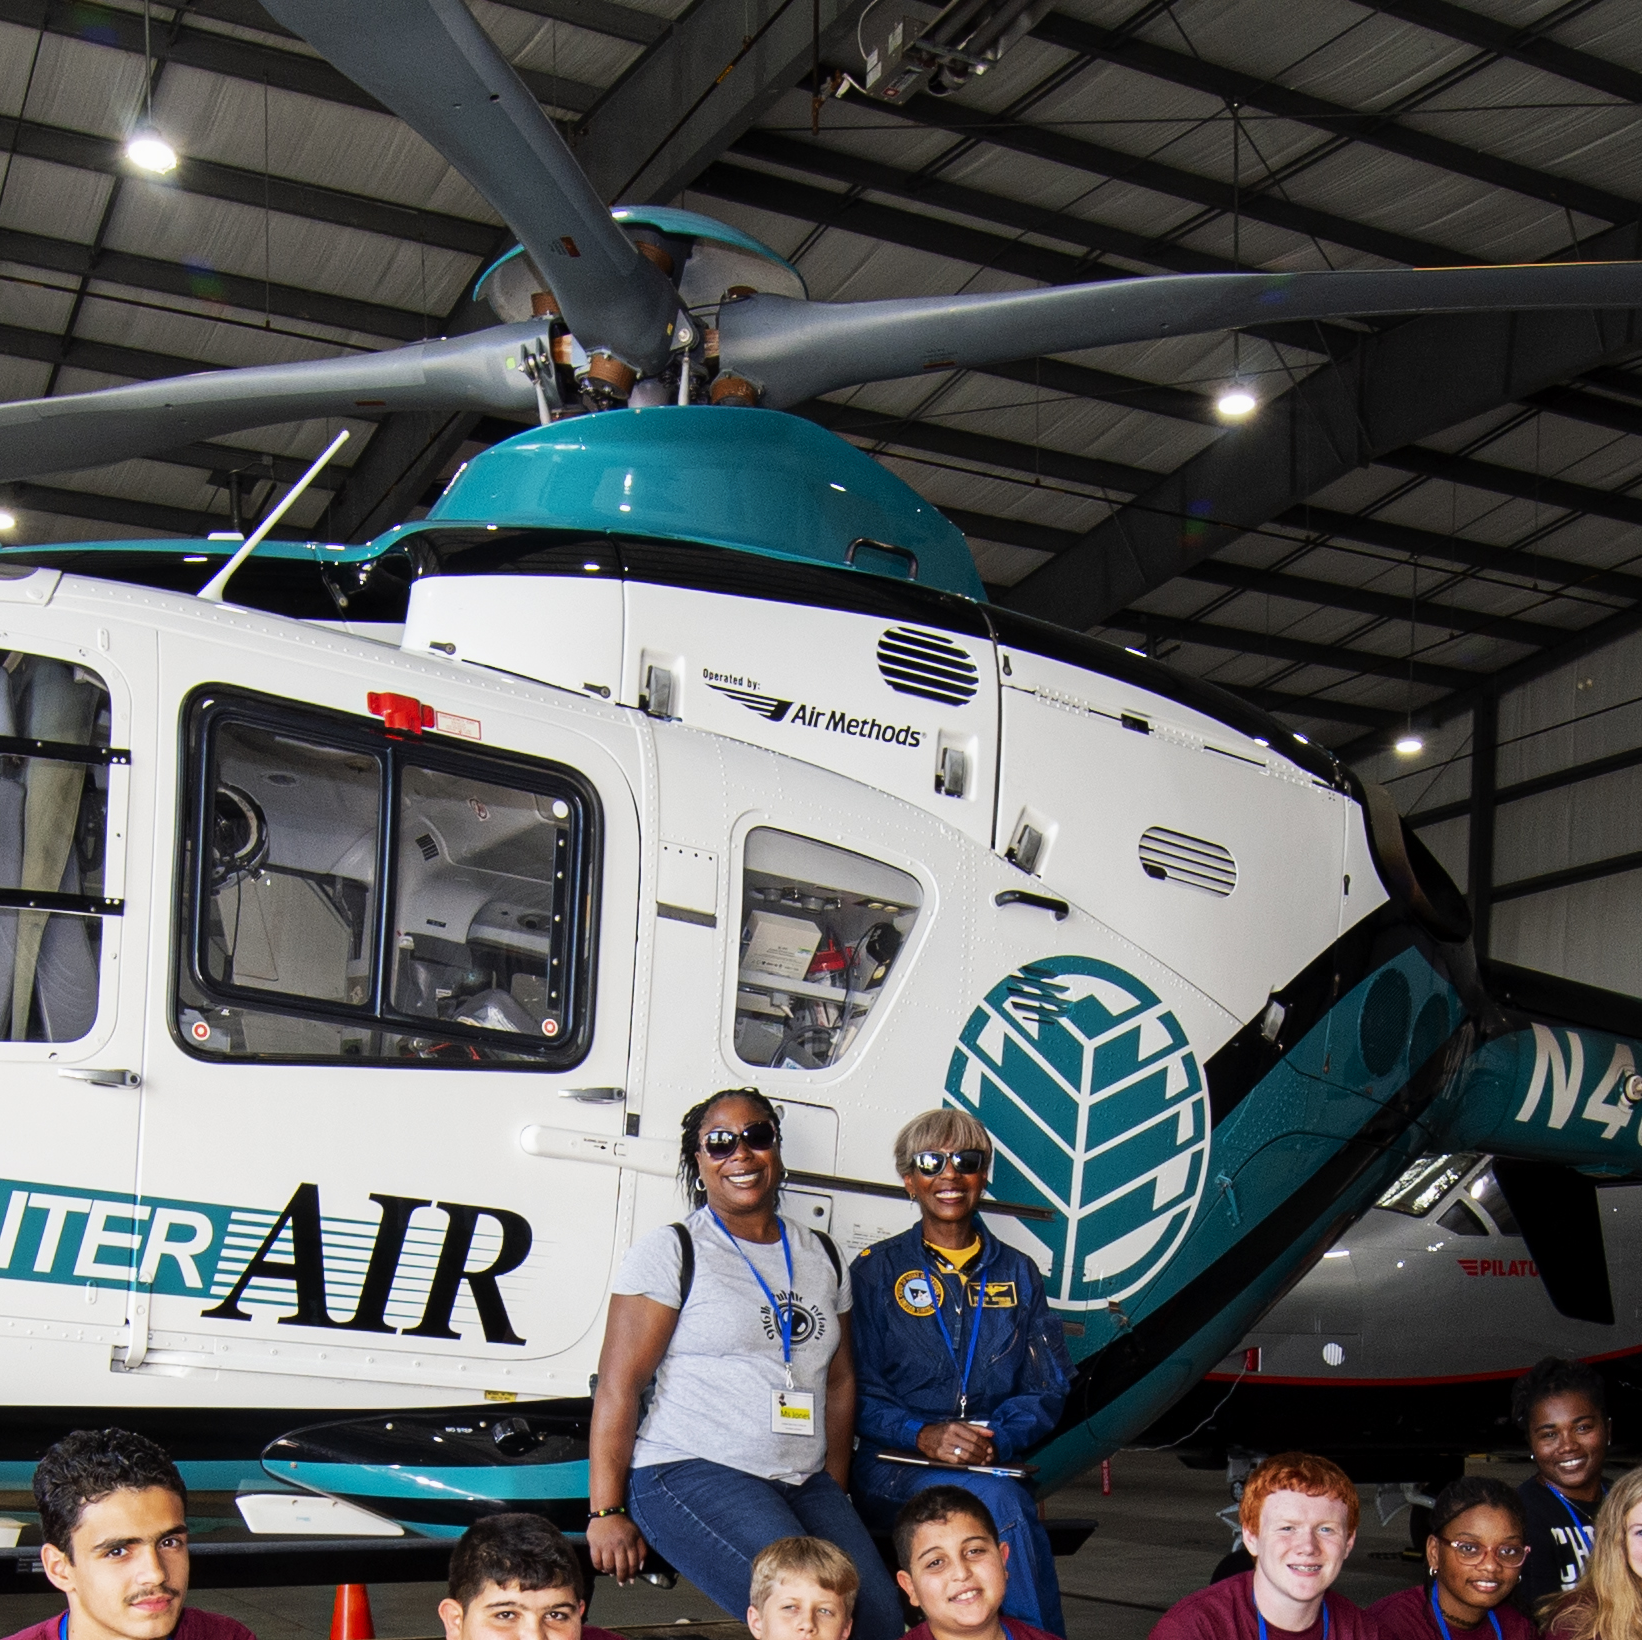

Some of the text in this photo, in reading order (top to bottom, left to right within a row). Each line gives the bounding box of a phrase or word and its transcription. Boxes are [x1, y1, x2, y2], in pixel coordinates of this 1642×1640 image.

[702, 667, 761, 691] Operated by:
[790, 704, 922, 748] Air Methods
[200, 1182, 534, 1348] AIR
[1480, 1259, 1540, 1277] PILATU
